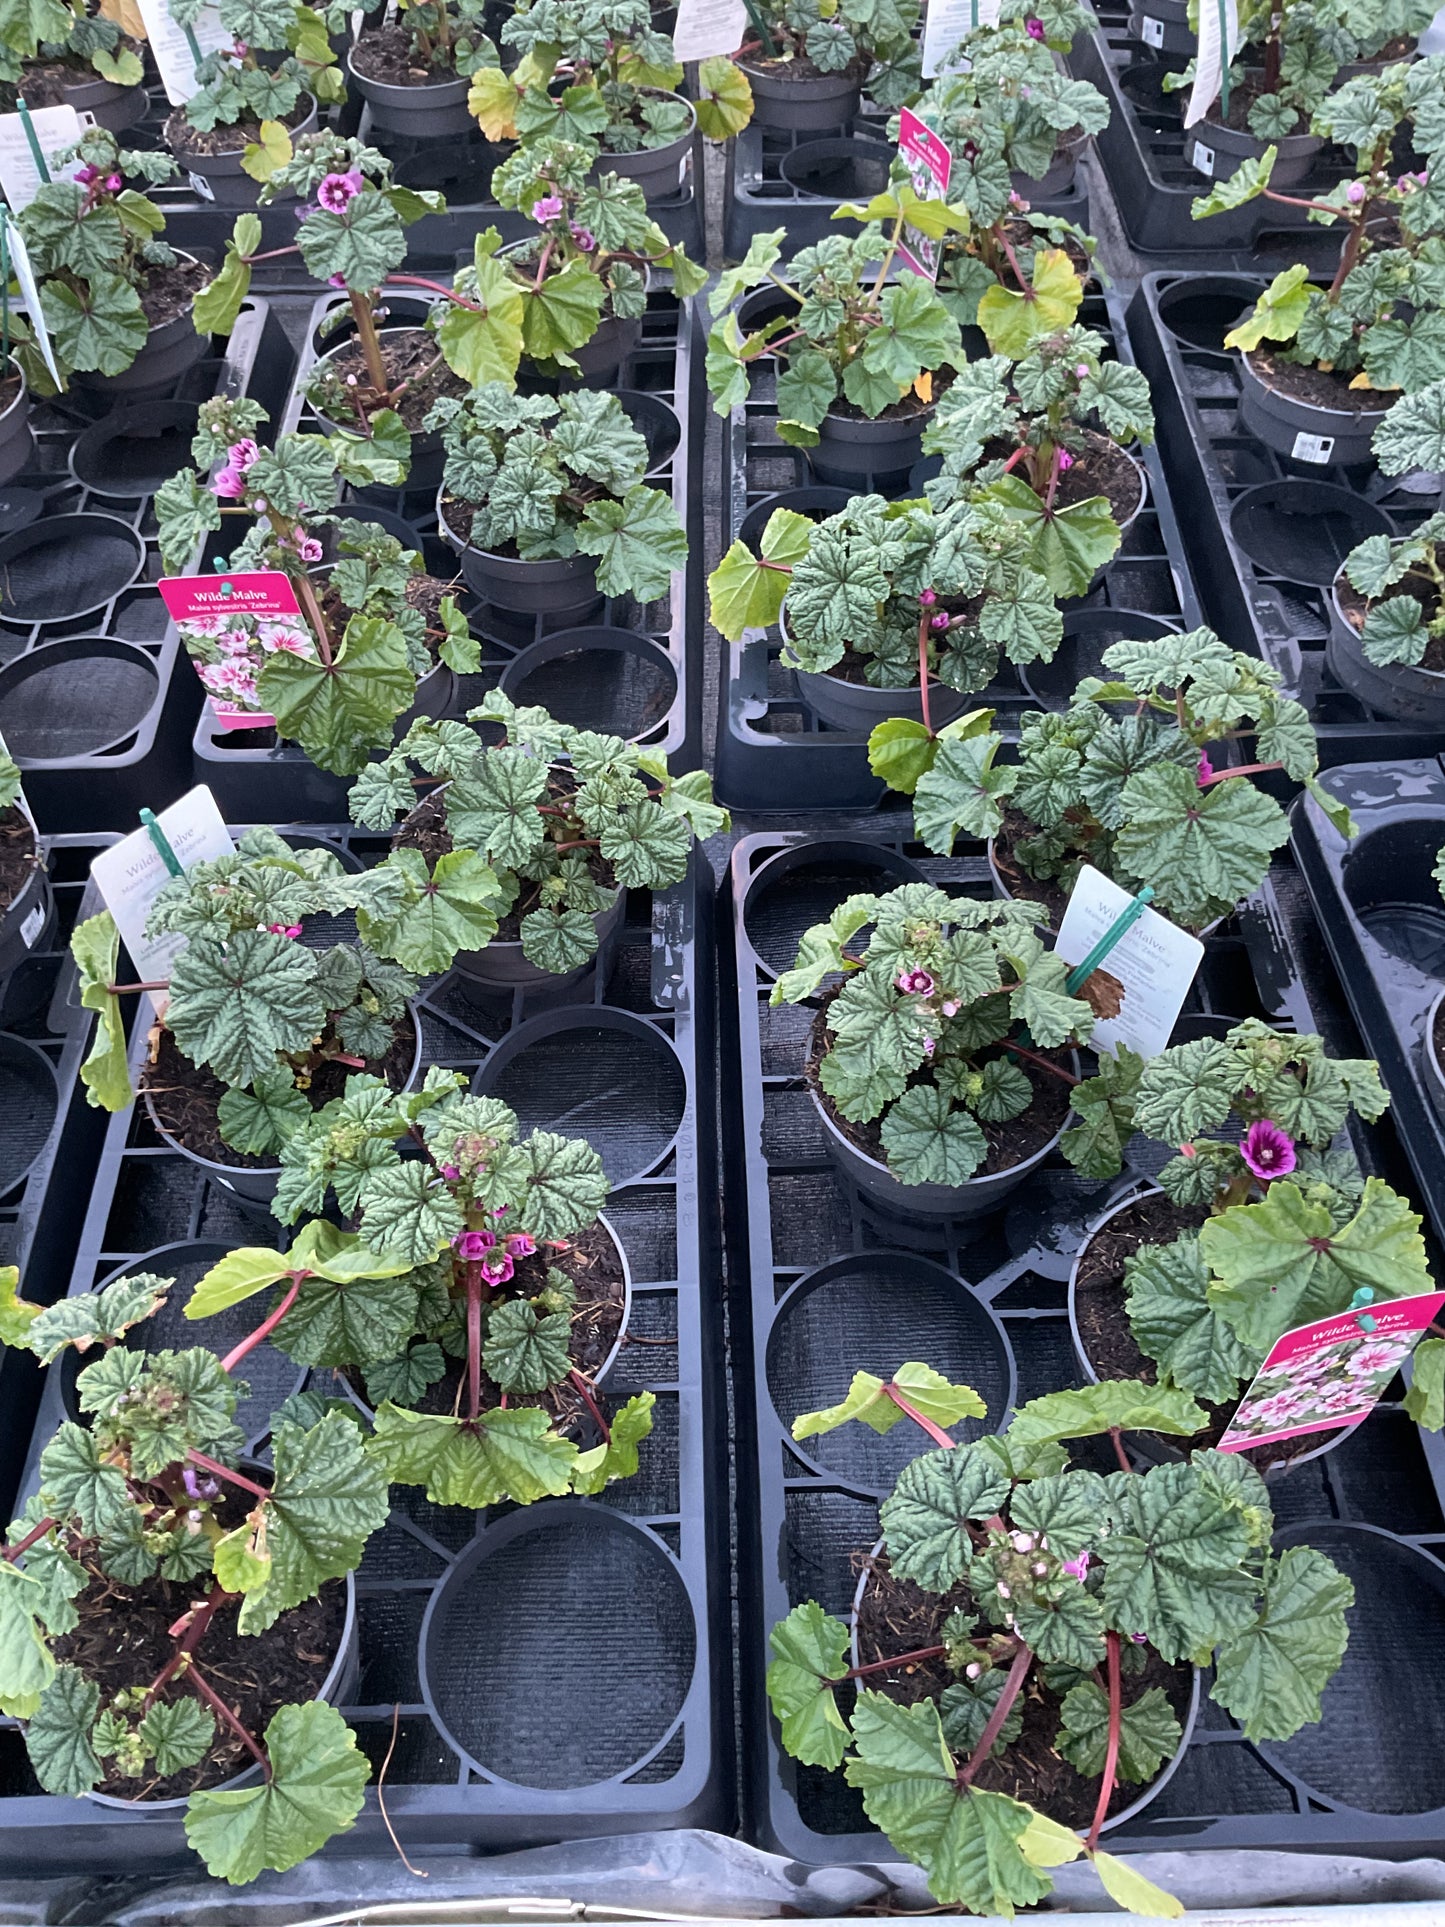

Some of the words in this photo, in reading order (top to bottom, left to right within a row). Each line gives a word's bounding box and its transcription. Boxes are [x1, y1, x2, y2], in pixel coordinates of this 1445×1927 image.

[231, 590, 268, 601] Malve
[173, 828, 194, 849] alve
[1098, 901, 1118, 921] Wil
[1131, 925, 1166, 953] Malve
[1311, 1323, 1355, 1342] Wilde
[1374, 1313, 1405, 1325] alve
